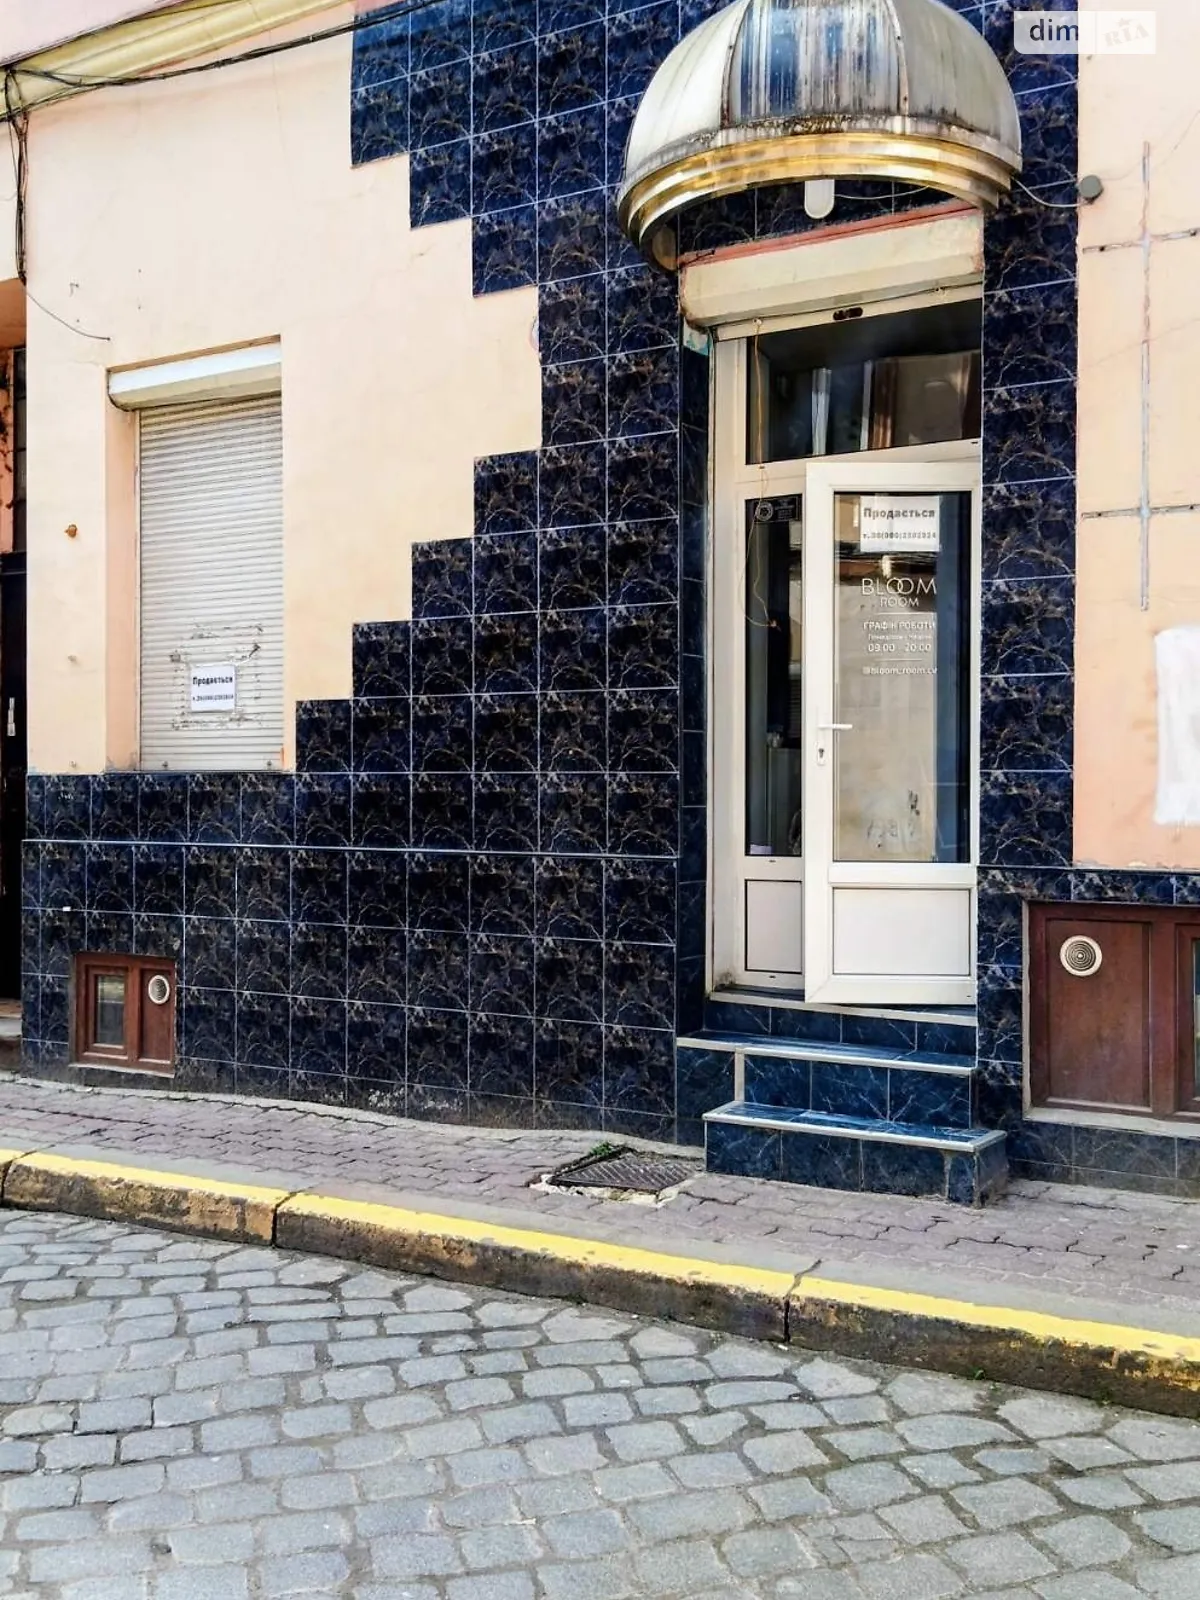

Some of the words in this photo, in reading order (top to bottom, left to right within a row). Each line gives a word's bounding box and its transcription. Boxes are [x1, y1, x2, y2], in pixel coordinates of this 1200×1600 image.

[863, 507, 936, 520] Продається
[862, 577, 938, 595] BLOOM
[880, 597, 920, 608] ROOM
